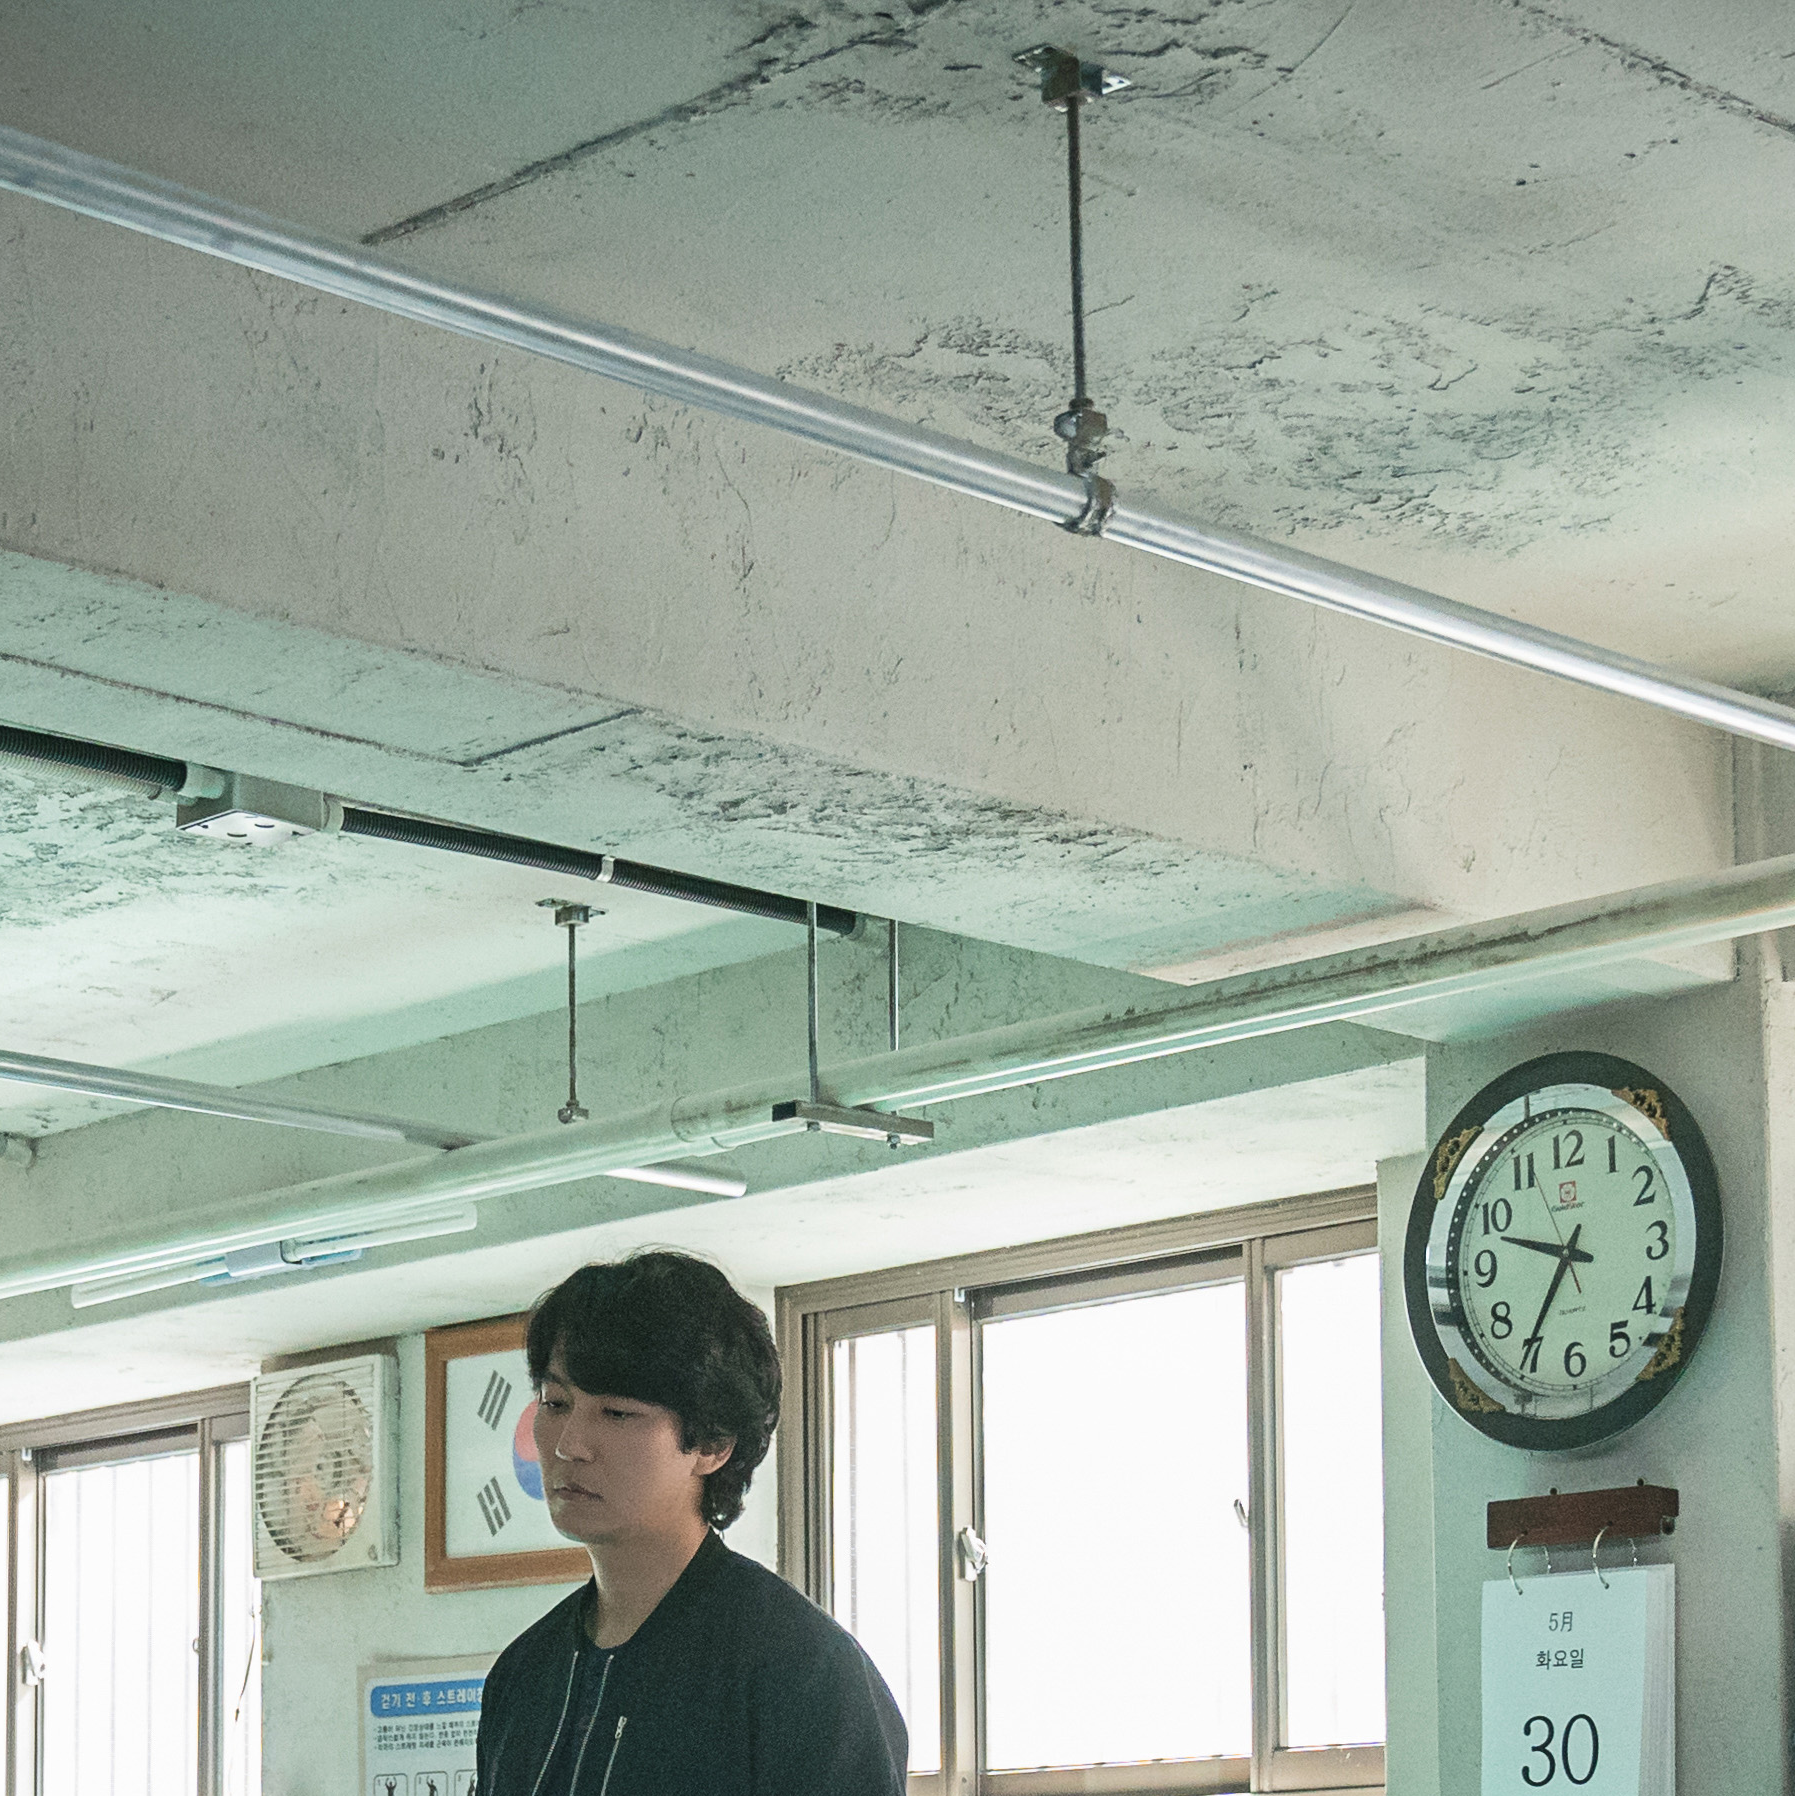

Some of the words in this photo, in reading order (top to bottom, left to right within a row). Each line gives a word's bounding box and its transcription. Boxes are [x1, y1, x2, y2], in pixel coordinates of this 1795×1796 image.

[1552, 1129, 1585, 1170] 12
[1606, 1135, 1619, 1174] 1
[1513, 1152, 1537, 1191] 11
[1632, 1165, 1656, 1207] 2
[1481, 1198, 1512, 1235] 10
[1645, 1220, 1669, 1260] 3
[1474, 1249, 1498, 1289] 9
[1632, 1275, 1656, 1315] 4
[1490, 1301, 1513, 1340] 8
[1608, 1320, 1632, 1358] 5
[1520, 1336, 1541, 1373] 7
[1563, 1341, 1586, 1378] 6
[1548, 1611, 1574, 1633] 5月
[1535, 1648, 1585, 1671] 화요일
[381, 1693, 401, 1710] 걷기
[1520, 1713, 1600, 1788] 30
